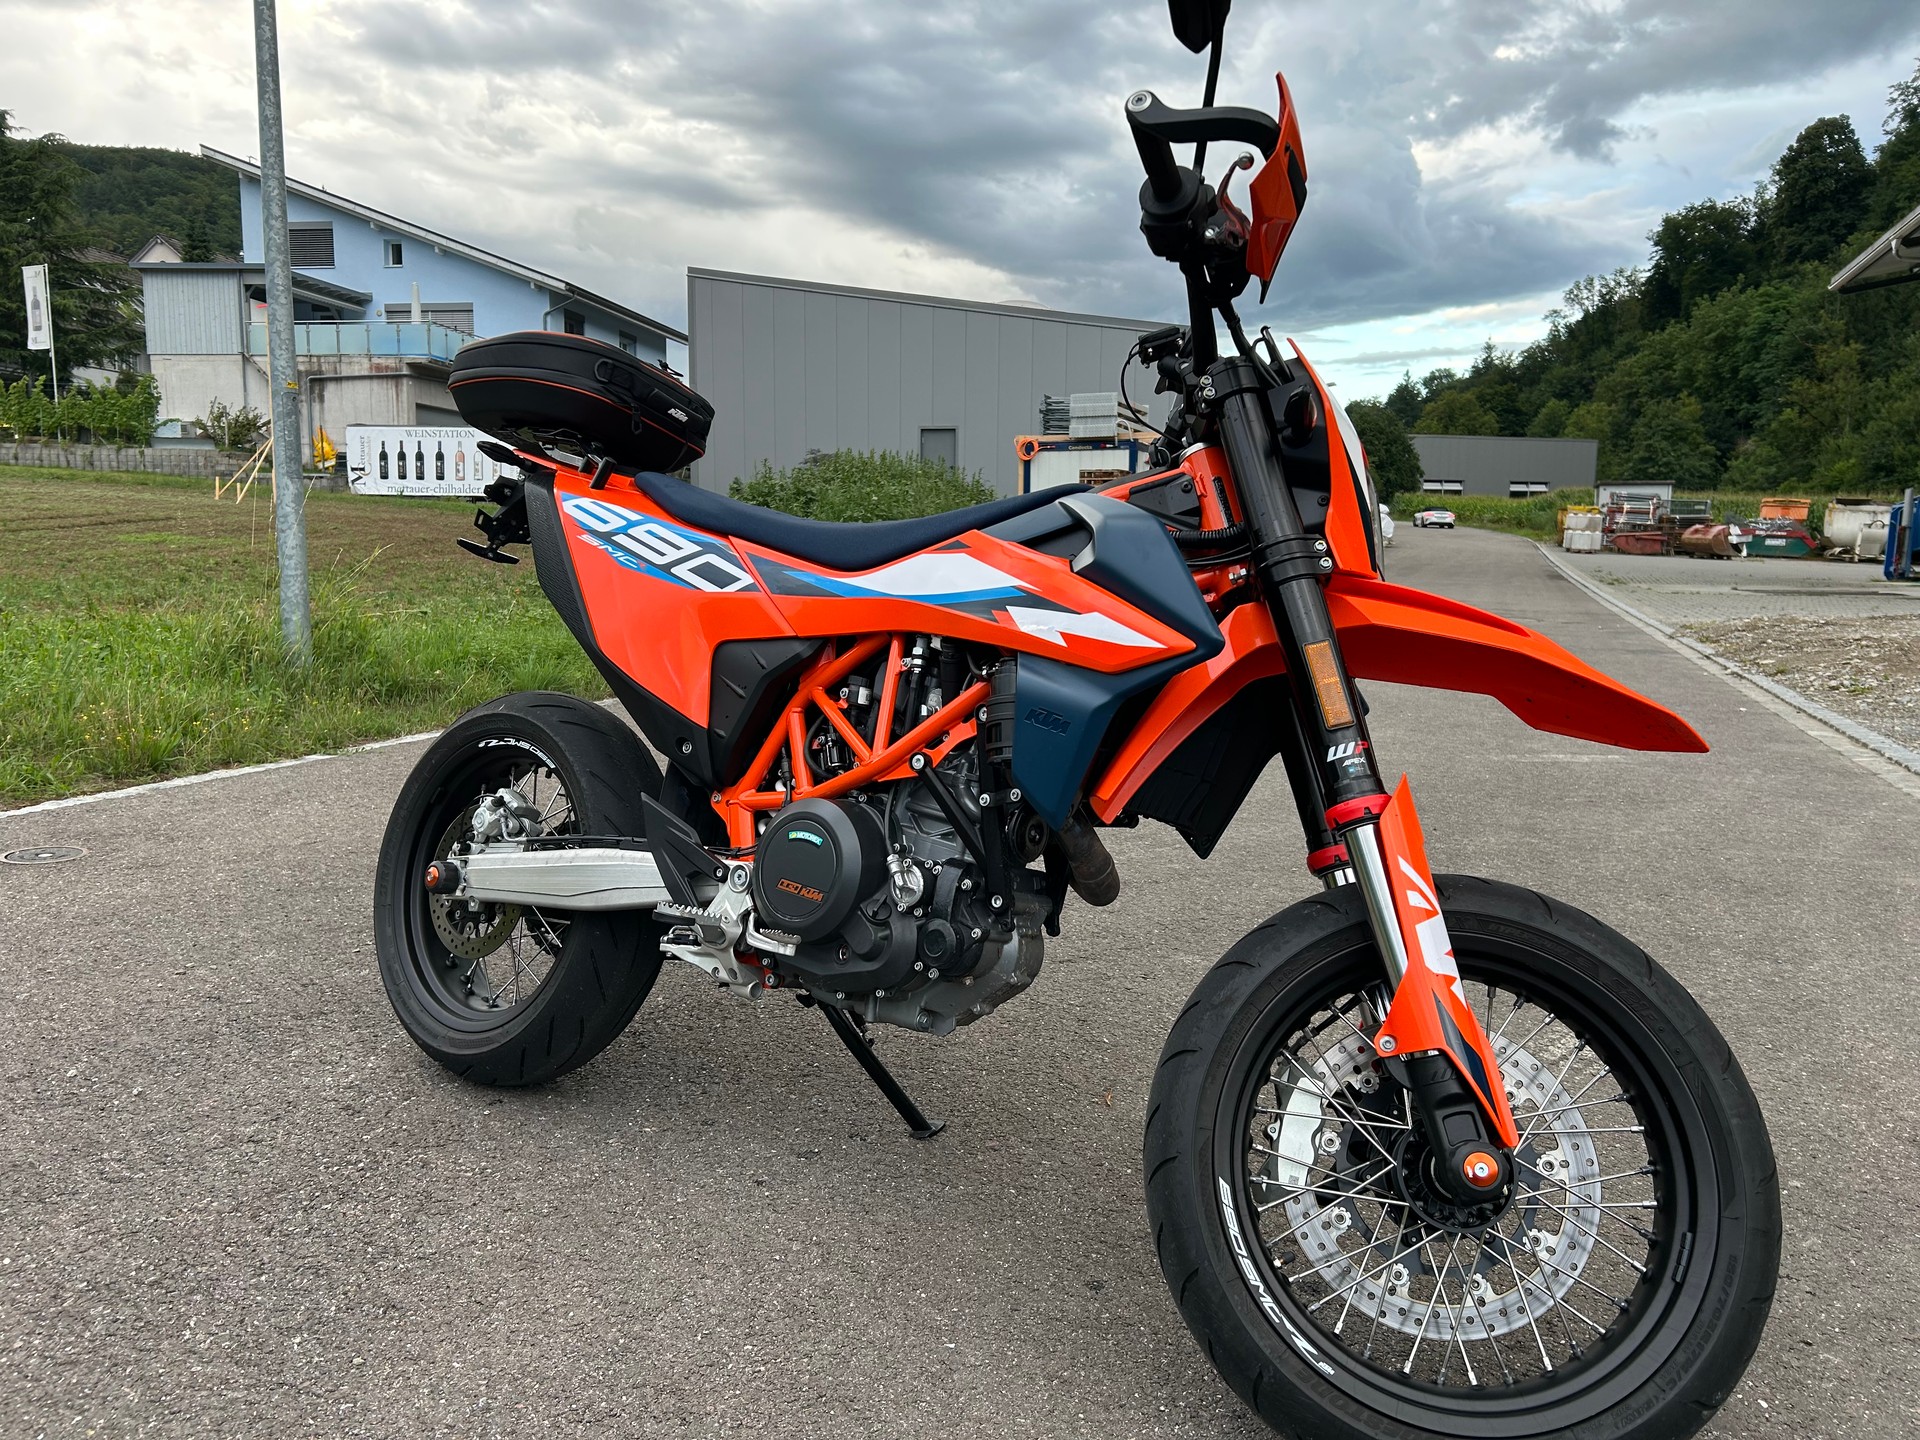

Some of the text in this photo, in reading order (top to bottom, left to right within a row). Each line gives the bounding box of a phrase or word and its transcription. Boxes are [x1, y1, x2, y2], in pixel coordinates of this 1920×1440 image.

[405, 429, 475, 439] WEINSTATION
[562, 498, 754, 592] 690
[1024, 707, 1071, 736] KTM
[1326, 740, 1369, 762] WP
[1342, 757, 1366, 767] APEX
[800, 886, 824, 902] KTM
